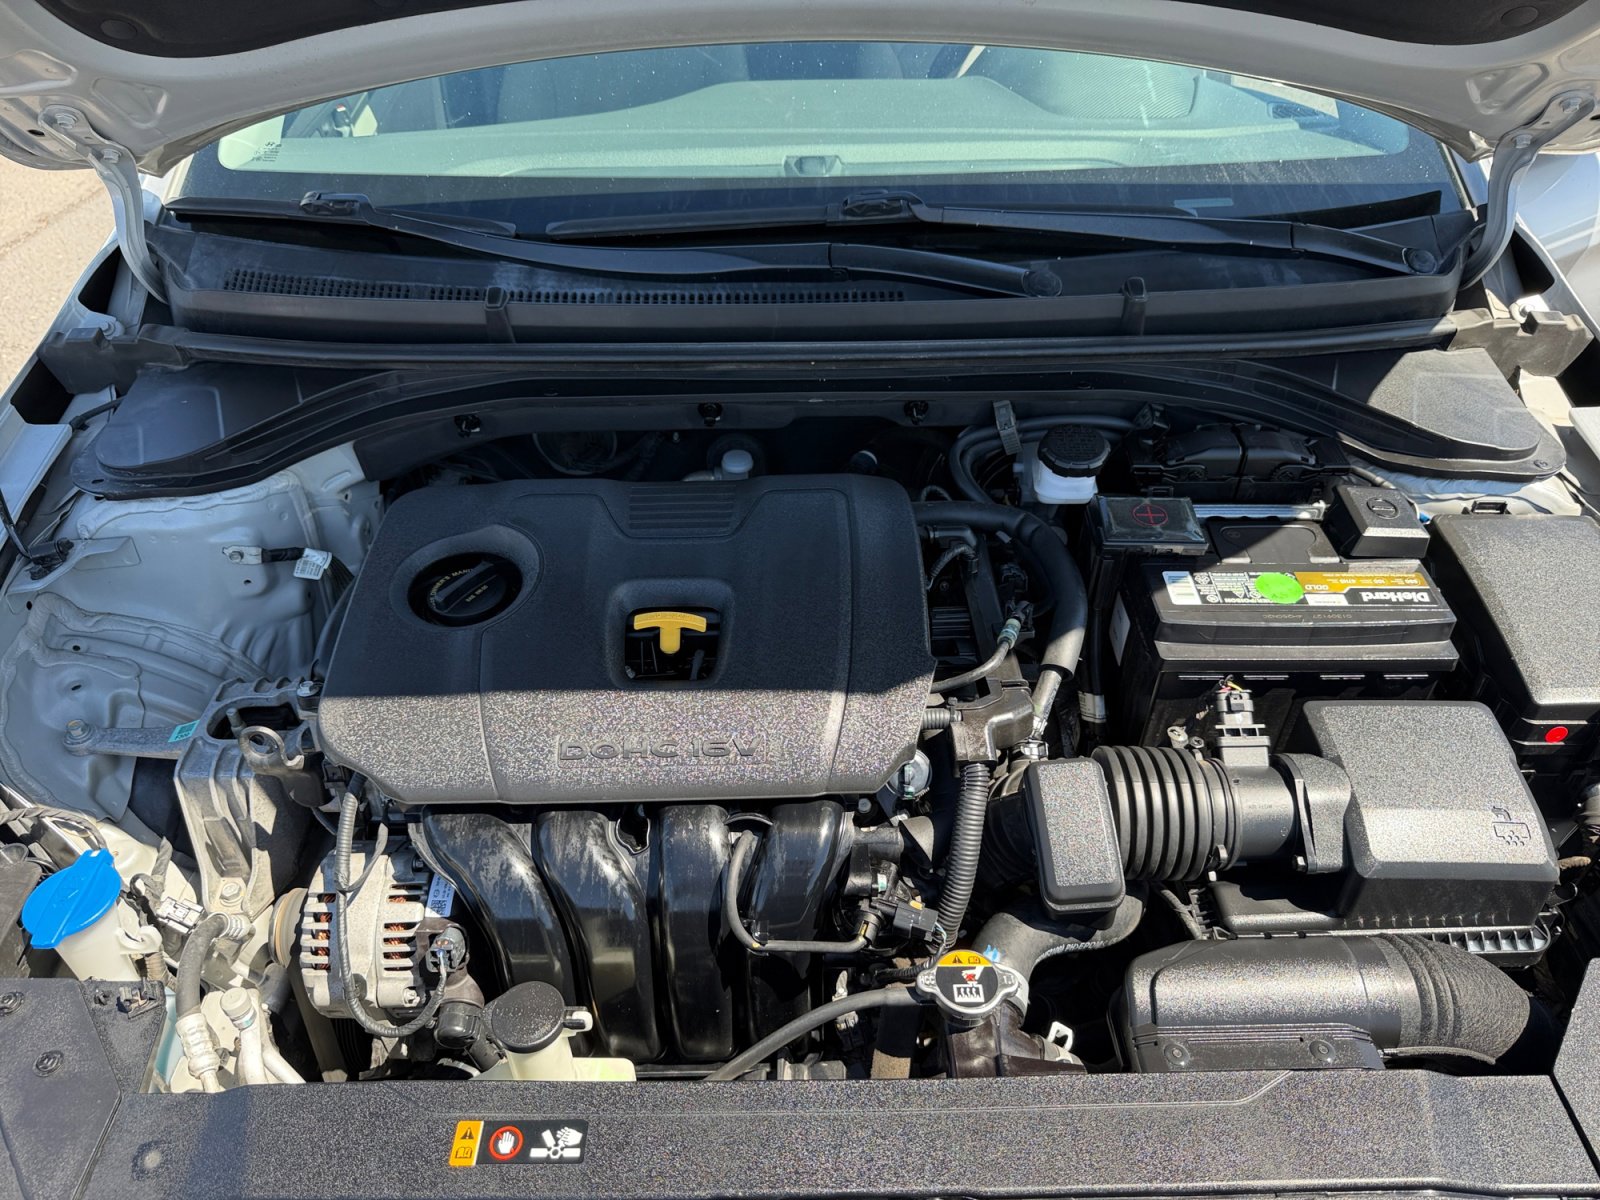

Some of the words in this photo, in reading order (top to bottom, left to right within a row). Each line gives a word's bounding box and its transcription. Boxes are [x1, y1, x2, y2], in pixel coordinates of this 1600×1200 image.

[1360, 591, 1429, 602] DieHard
[560, 739, 679, 760] DOHC
[690, 735, 763, 757] 16V
